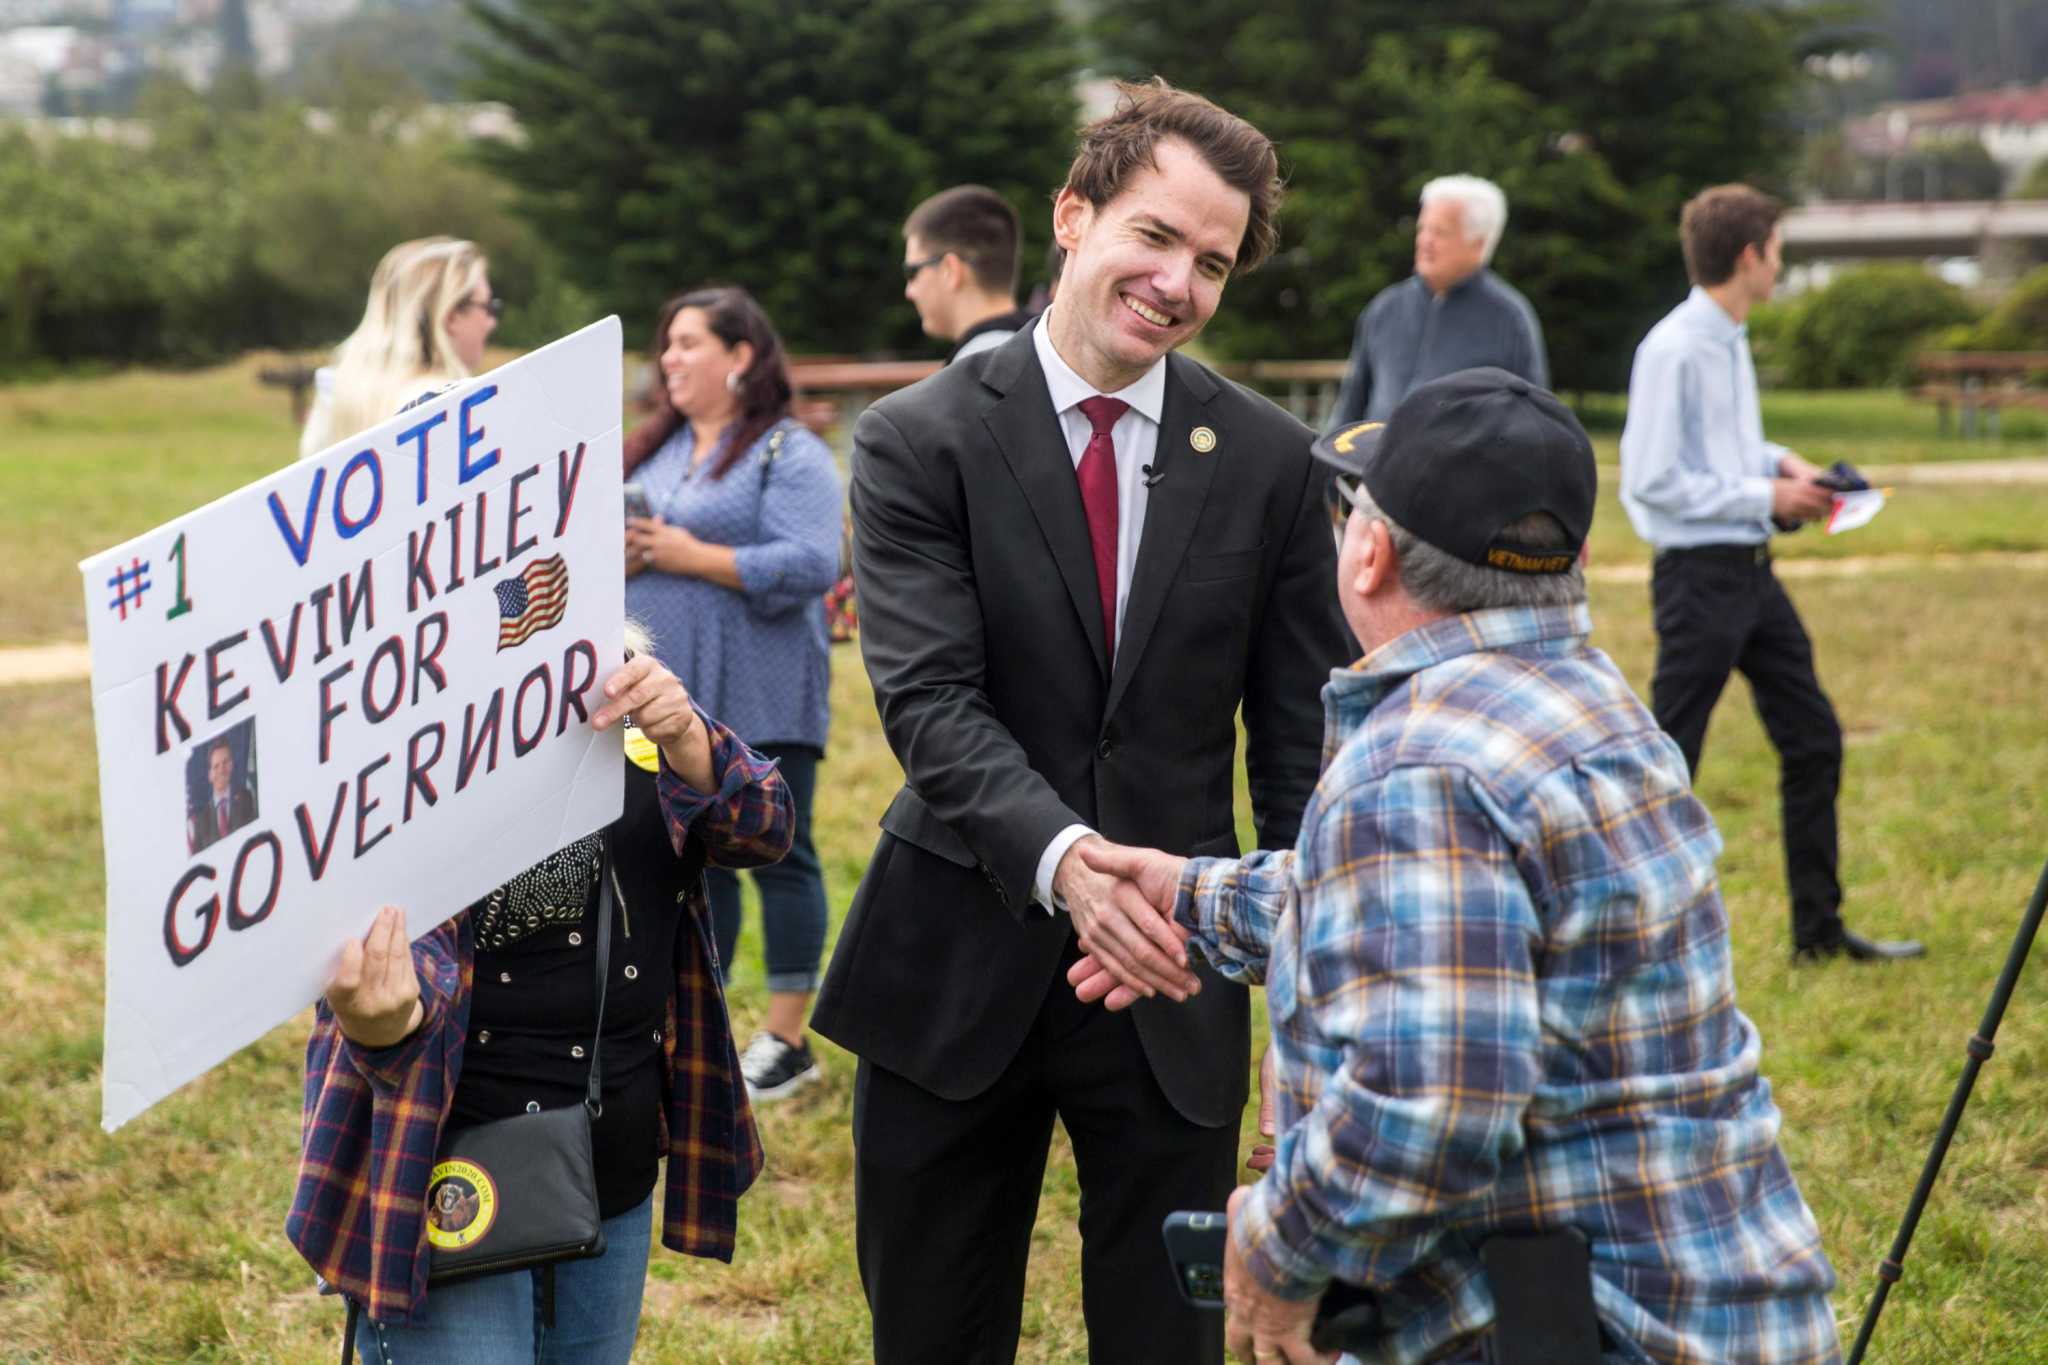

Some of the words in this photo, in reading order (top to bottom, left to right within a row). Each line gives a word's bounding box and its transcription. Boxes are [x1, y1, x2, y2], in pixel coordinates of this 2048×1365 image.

[108, 531, 193, 621] #1
[268, 385, 501, 567] VOTE
[155, 559, 376, 755] KEVIN
[405, 442, 587, 612] KILEY
[163, 639, 598, 967] GOVERNOR
[317, 611, 449, 764] FOR
